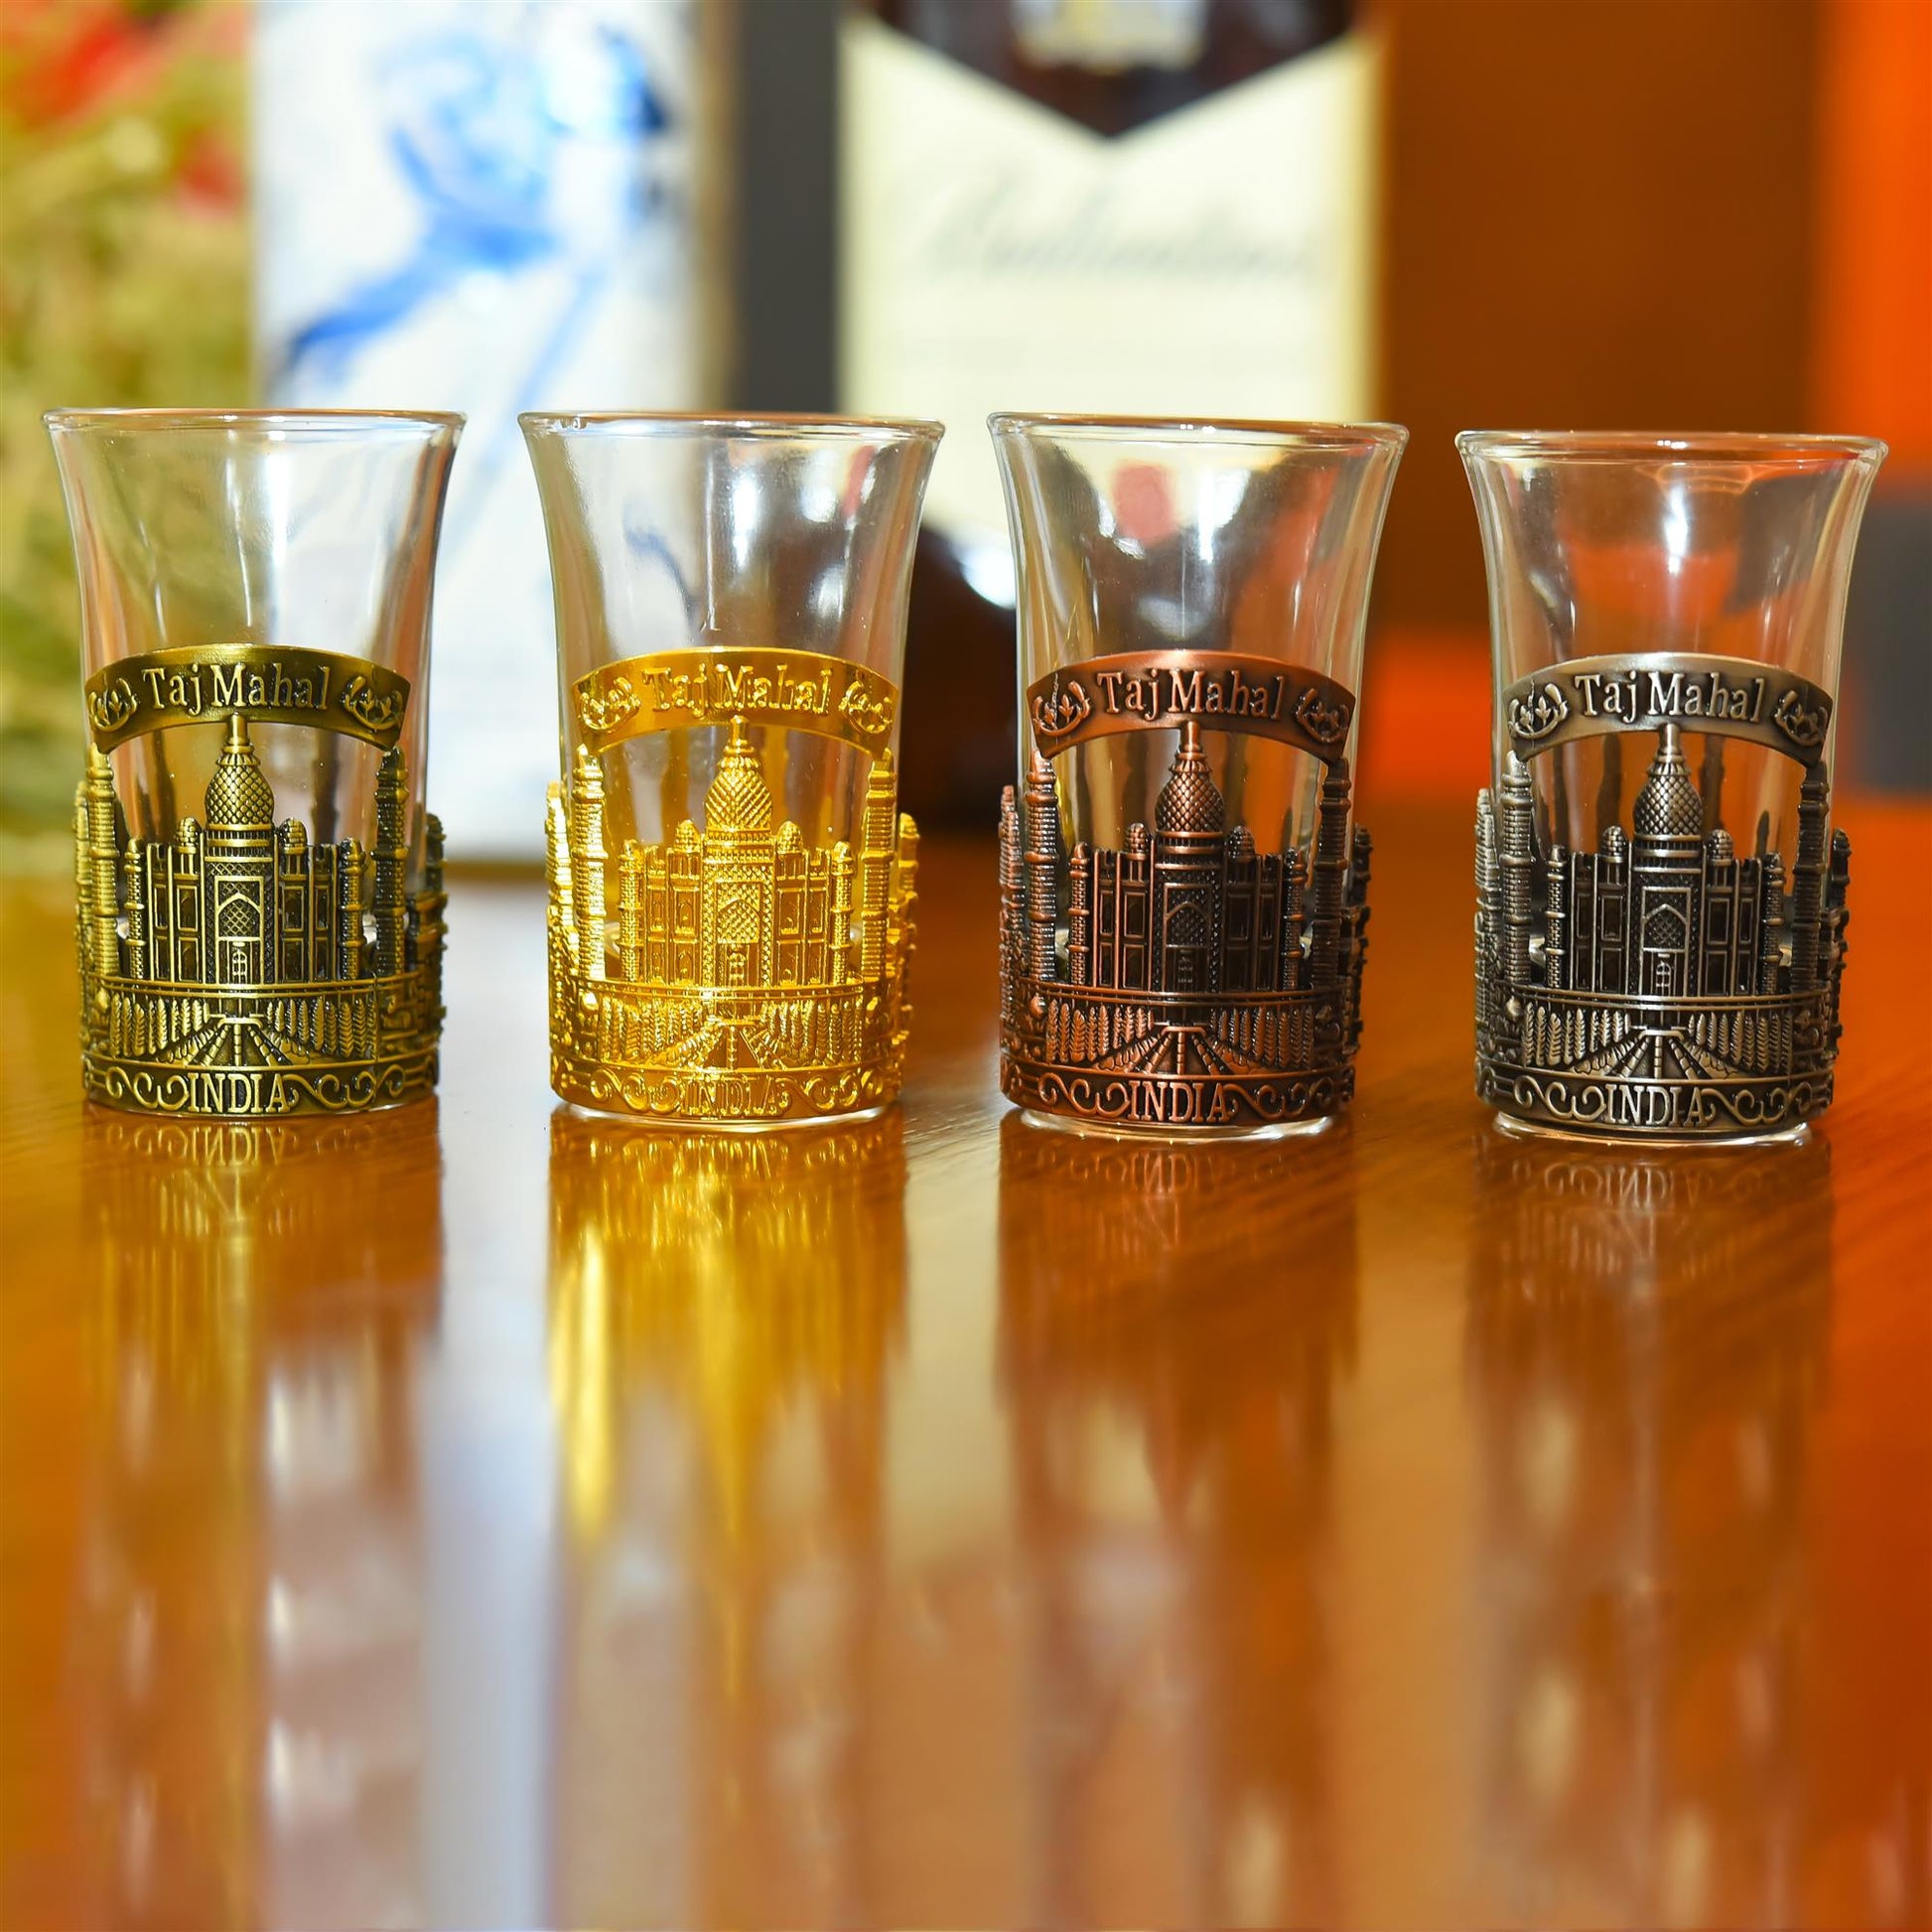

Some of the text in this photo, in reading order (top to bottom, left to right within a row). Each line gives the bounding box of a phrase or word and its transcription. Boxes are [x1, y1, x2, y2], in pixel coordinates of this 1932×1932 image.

[141, 661, 331, 716] Taj Mahal
[642, 663, 833, 718] Taj Mahal
[1096, 667, 1287, 722] Taj Mahal
[1574, 670, 1765, 724] Taj Mahal
[187, 1071, 291, 1114] INDIA
[680, 1074, 785, 1116] INDIA
[1127, 1079, 1231, 1124] INDIA
[1603, 1083, 1709, 1128] INDIA
